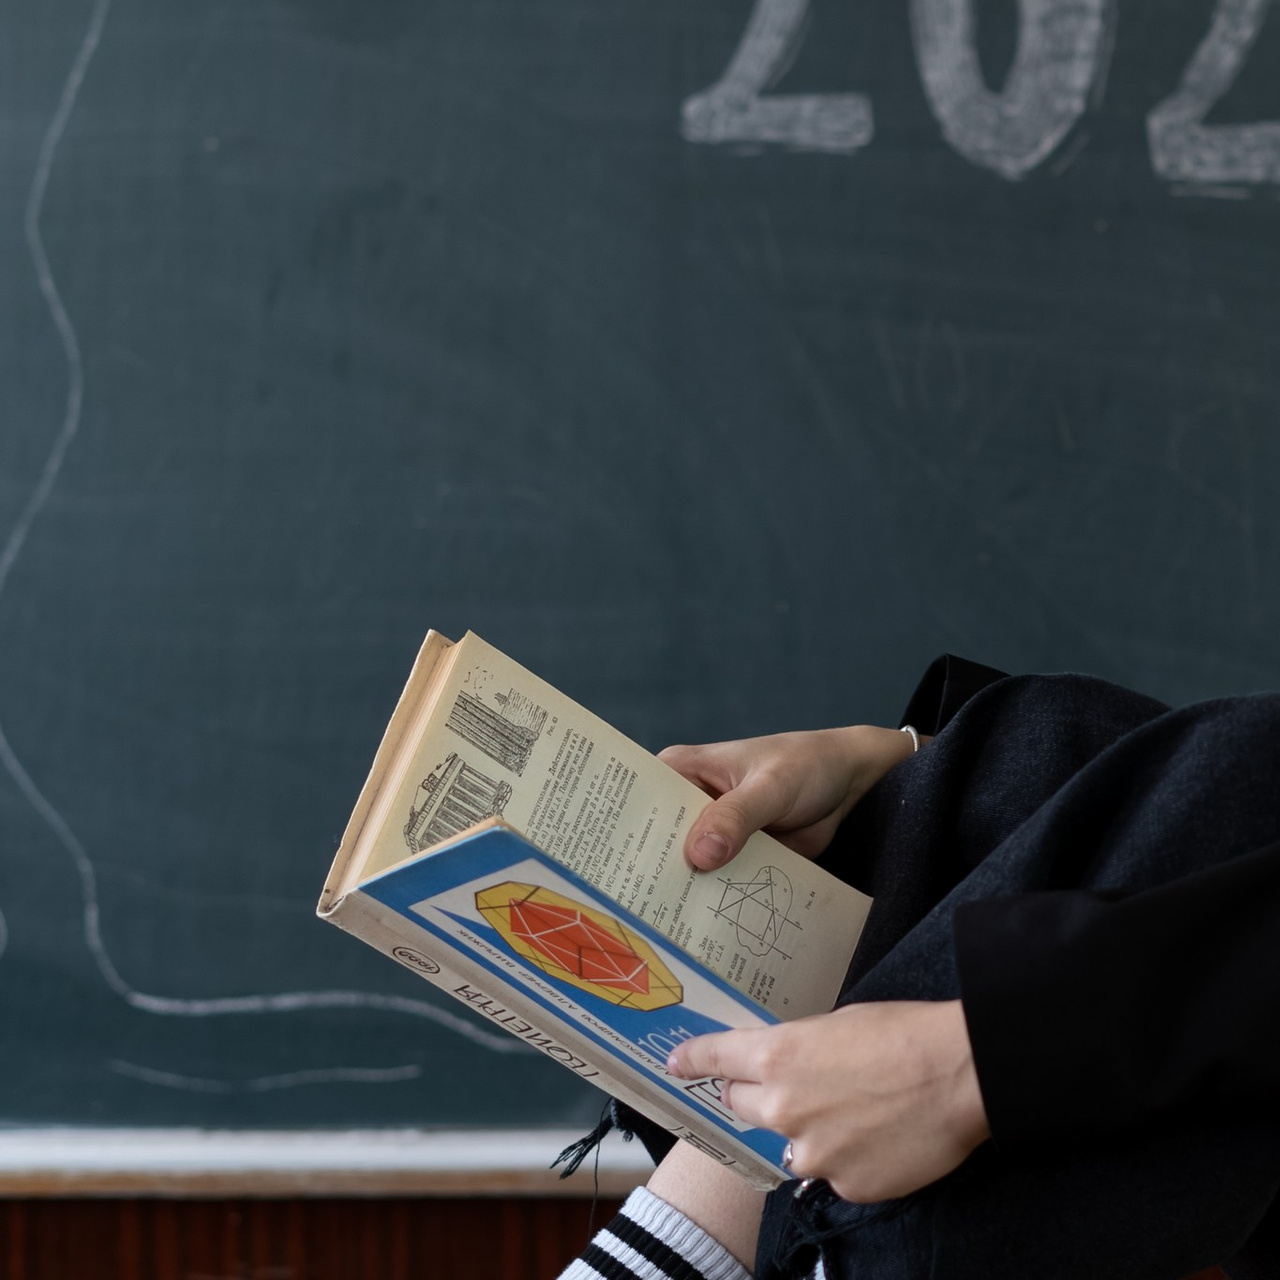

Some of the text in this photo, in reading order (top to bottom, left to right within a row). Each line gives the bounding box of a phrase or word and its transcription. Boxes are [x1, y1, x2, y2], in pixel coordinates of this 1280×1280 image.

[528, 727, 573, 827] прямоугольник. Действительно,
[536, 781, 559, 830] параллельными
[557, 751, 573, 779] прямыми
[553, 809, 566, 832] Длины
[563, 798, 571, 810] его
[568, 776, 581, 799] сторон
[576, 742, 594, 774] обозначим
[559, 766, 575, 794] Поэтому
[572, 753, 580, 765] все
[577, 736, 588, 752] углы
[588, 815, 601, 837] Пусть
[604, 785, 615, 800] угол
[611, 761, 624, 783] между
[612, 809, 621, 821] По
[618, 771, 639, 810] неравенству
[560, 835, 573, 858] любом
[589, 781, 596, 790] от
[569, 830, 586, 860] проведем
[583, 810, 594, 829] через
[597, 764, 612, 794] плоскости
[581, 855, 593, 878] пустим
[590, 835, 601, 854] тогда
[603, 806, 613, 825] точки
[637, 818, 654, 852] наклонная,
[652, 806, 659, 815] то
[603, 847, 614, 867] имеем
[647, 884, 655, 896] что
[674, 806, 686, 828] откуда
[671, 903, 684, 924] любое
[454, 986, 599, 1077] ГЕОМЕТРИЯ
